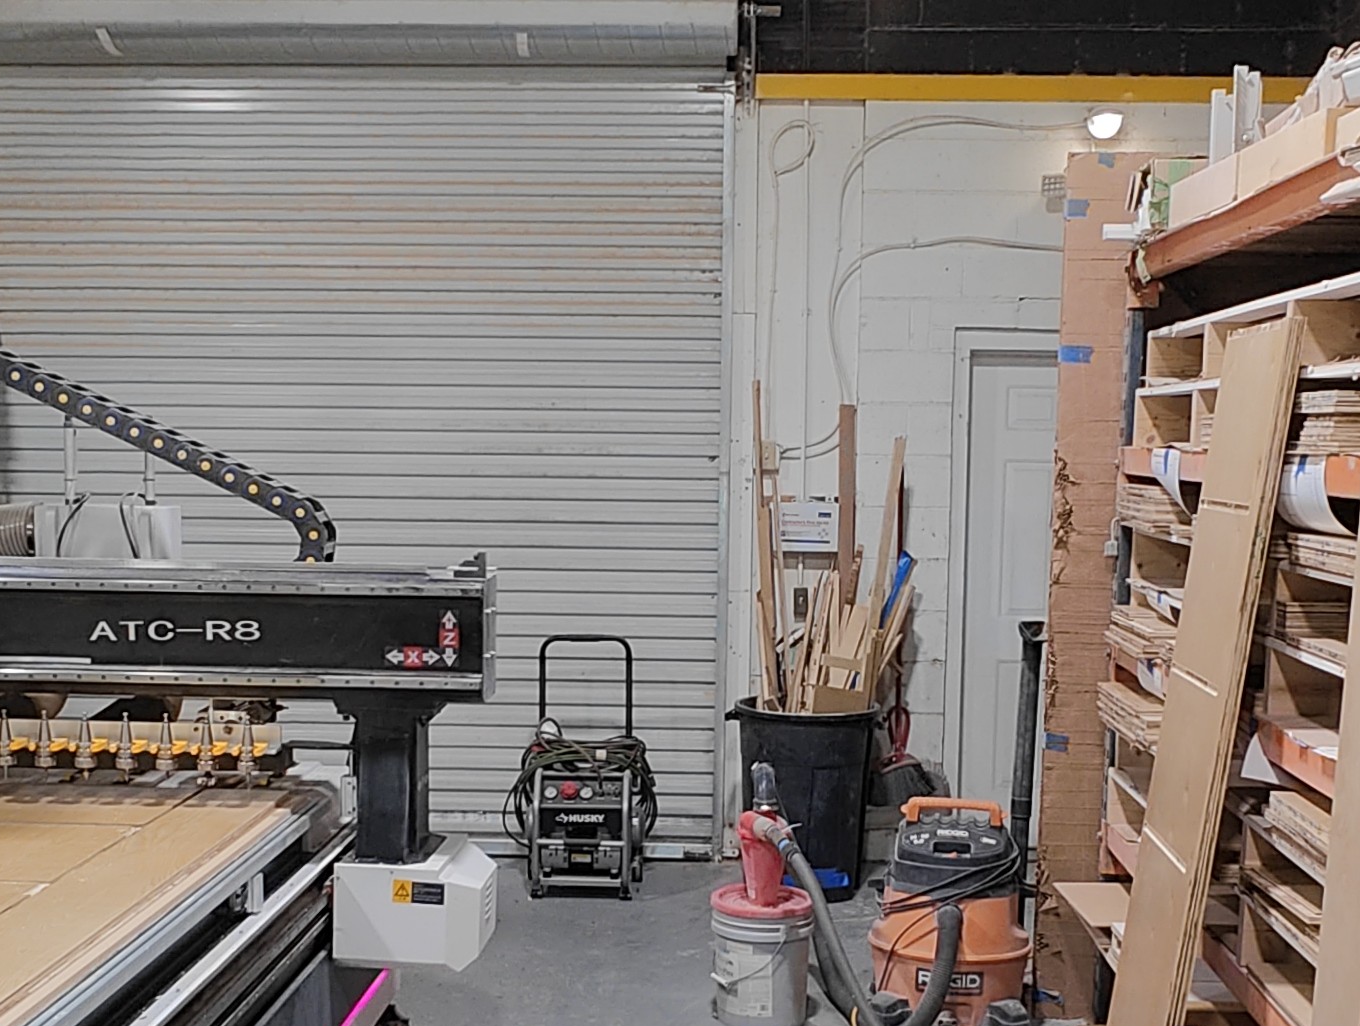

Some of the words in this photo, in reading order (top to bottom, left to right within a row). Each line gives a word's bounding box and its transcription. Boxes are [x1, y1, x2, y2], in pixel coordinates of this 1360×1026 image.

[88, 620, 262, 642] ATC-R8
[442, 632, 456, 646] Z
[406, 650, 421, 664] X
[568, 813, 606, 823] HUSKY
[917, 970, 981, 989] RGID
